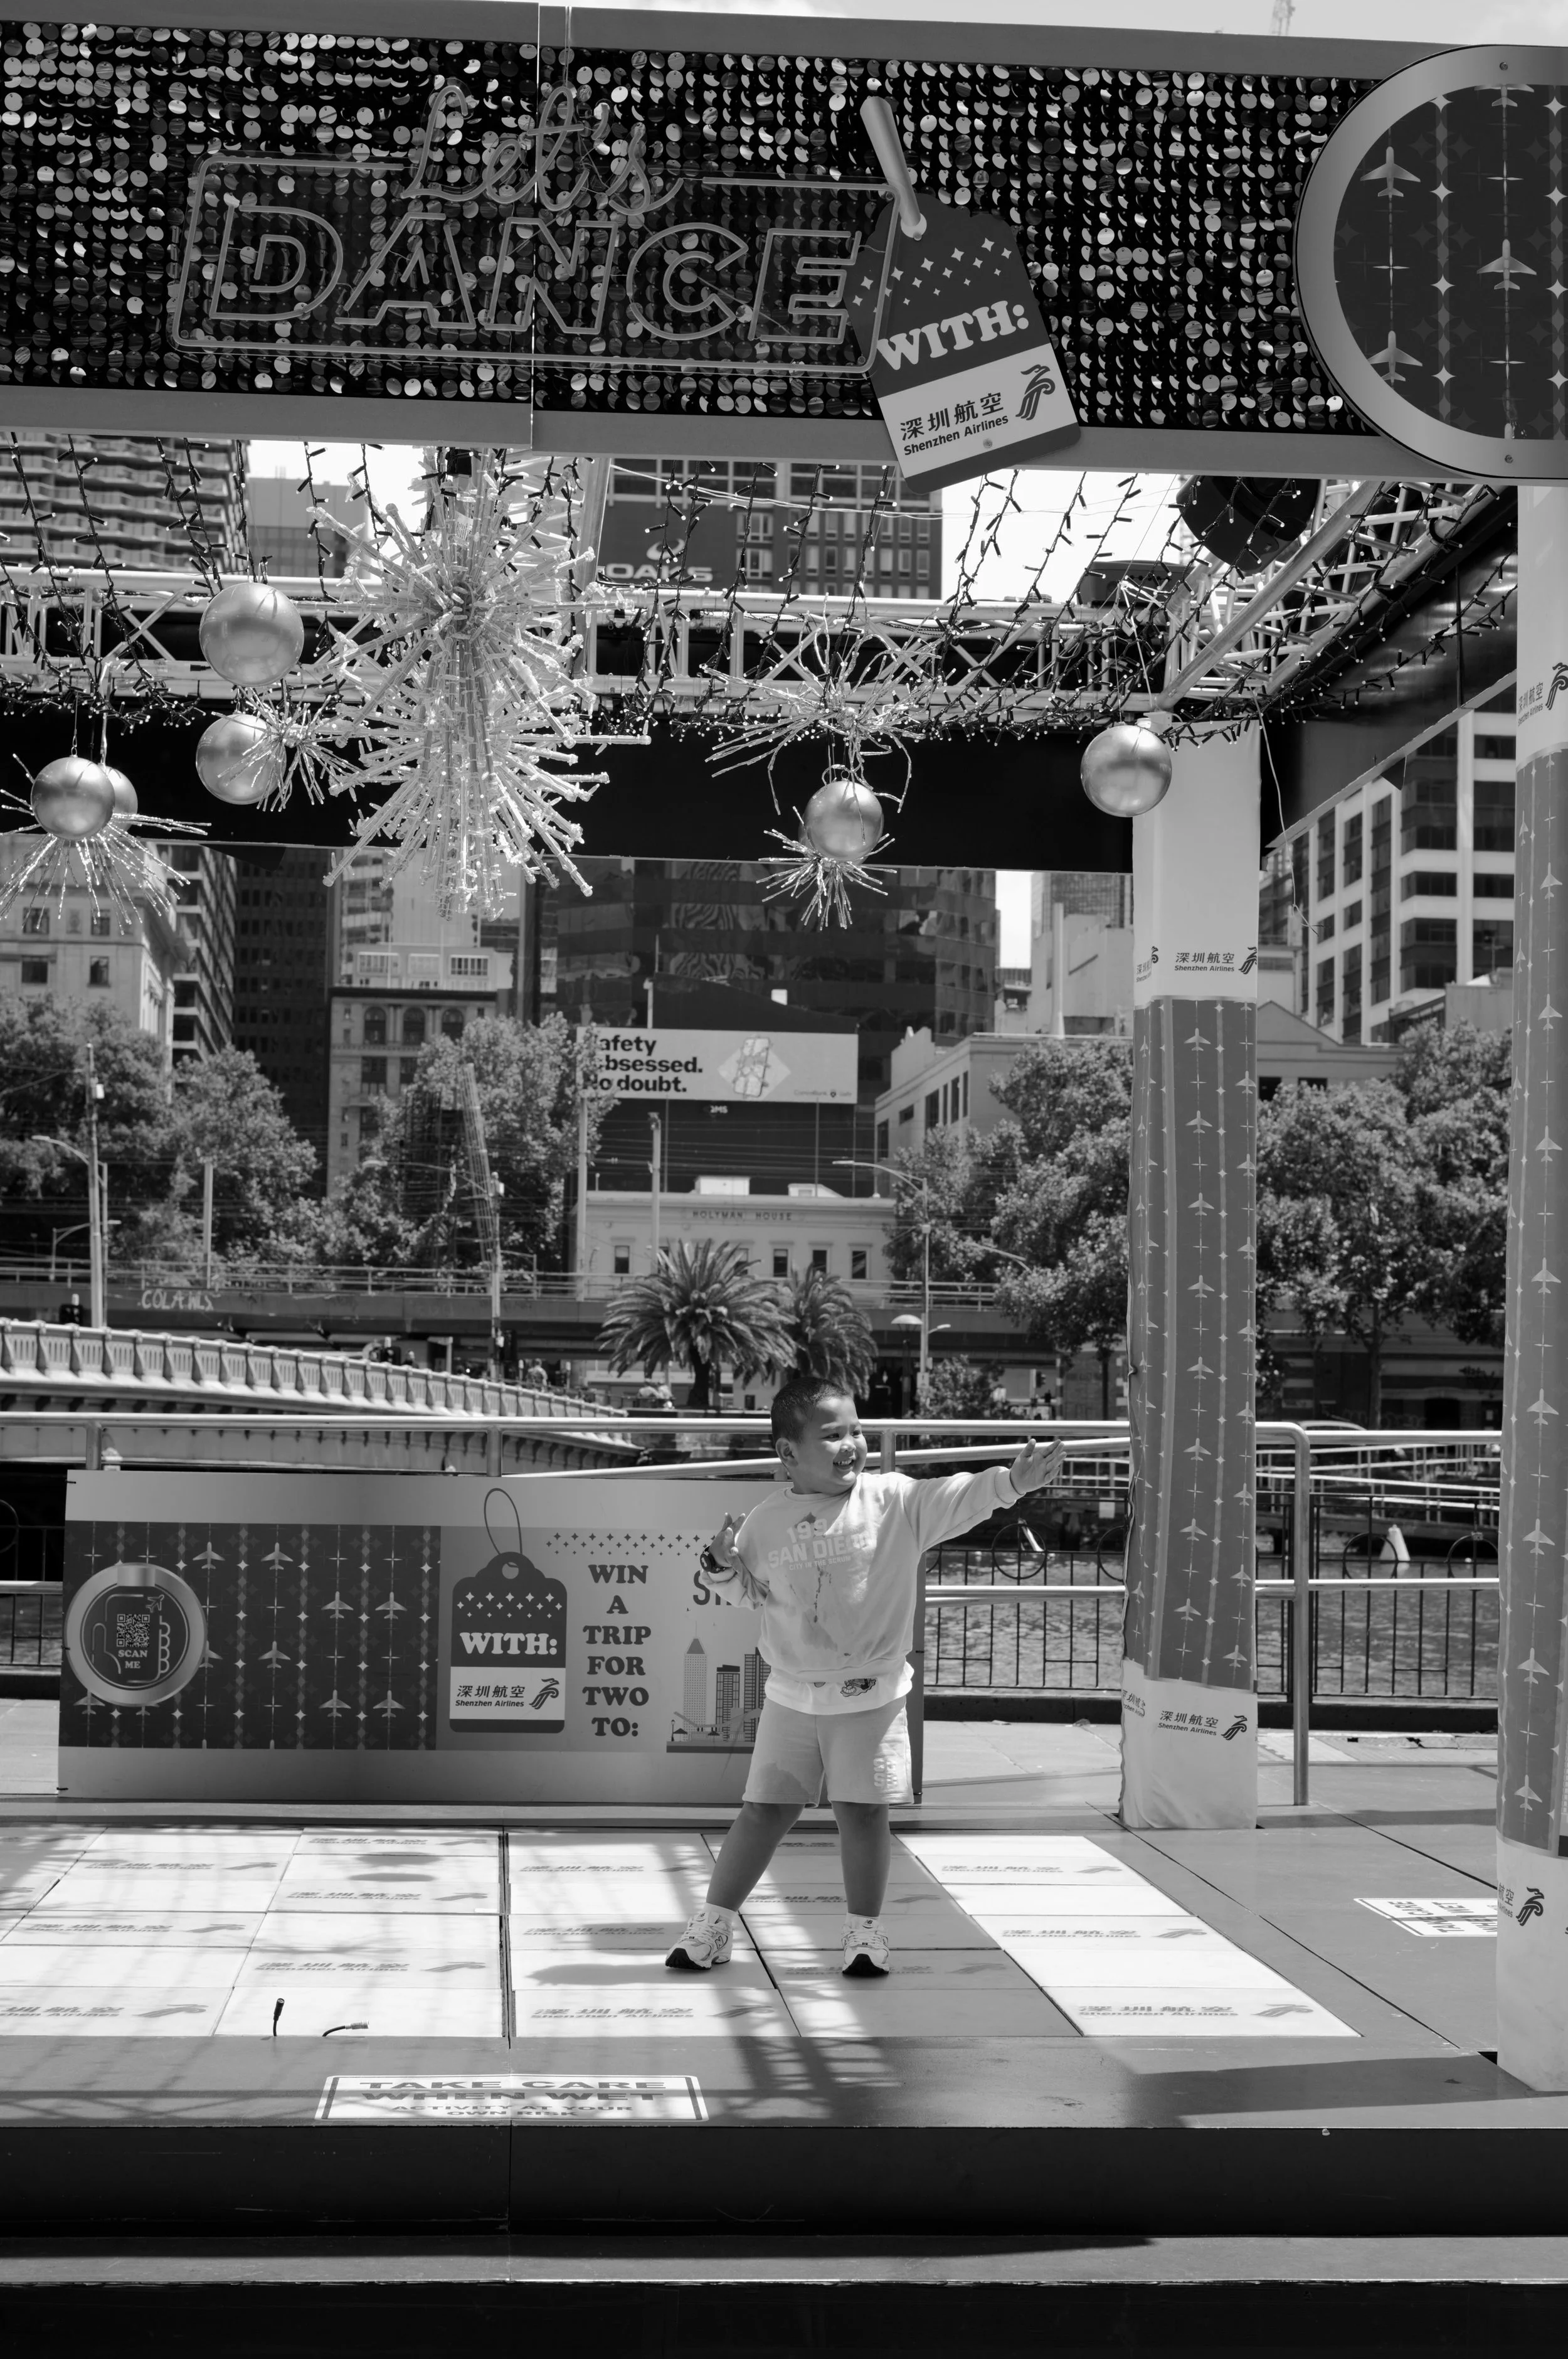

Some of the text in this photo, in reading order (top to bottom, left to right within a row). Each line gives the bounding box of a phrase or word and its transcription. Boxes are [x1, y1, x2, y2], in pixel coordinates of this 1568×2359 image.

[399, 83, 686, 217] Let's
[208, 197, 864, 343] DANCE
[876, 300, 1029, 371] WITH:
[899, 391, 1004, 441] 深圳航空
[903, 415, 1009, 455] Shenzhen Airlines
[605, 563, 713, 582] OAKS
[1175, 952, 1235, 964] 深圳航空
[598, 1034, 657, 1057] afety
[604, 1054, 703, 1073] bsessed.
[617, 1075, 687, 1093] doubt.
[692, 1210, 793, 1221] HOLYMAN HOUSE
[768, 1542, 808, 1568] SAN
[588, 1564, 649, 1585] WIN
[789, 1562, 803, 1570] CITY
[606, 1595, 629, 1614] A
[459, 1632, 558, 1655] WITH:
[582, 1625, 652, 1646] TRIP
[118, 1649, 148, 1658] SCAN
[125, 1661, 141, 1669] ME
[586, 1655, 646, 1676] FOR
[457, 1685, 526, 1698] 深圳航空
[582, 1686, 650, 1707] TWO
[591, 1717, 639, 1738] TO:
[1158, 1722, 1217, 1736] Shenzhen Airlines
[1160, 1710, 1219, 1729] 深圳航空
[359, 2080, 667, 2089] TAKE CARE
[362, 2092, 664, 2101] WHEN WET
